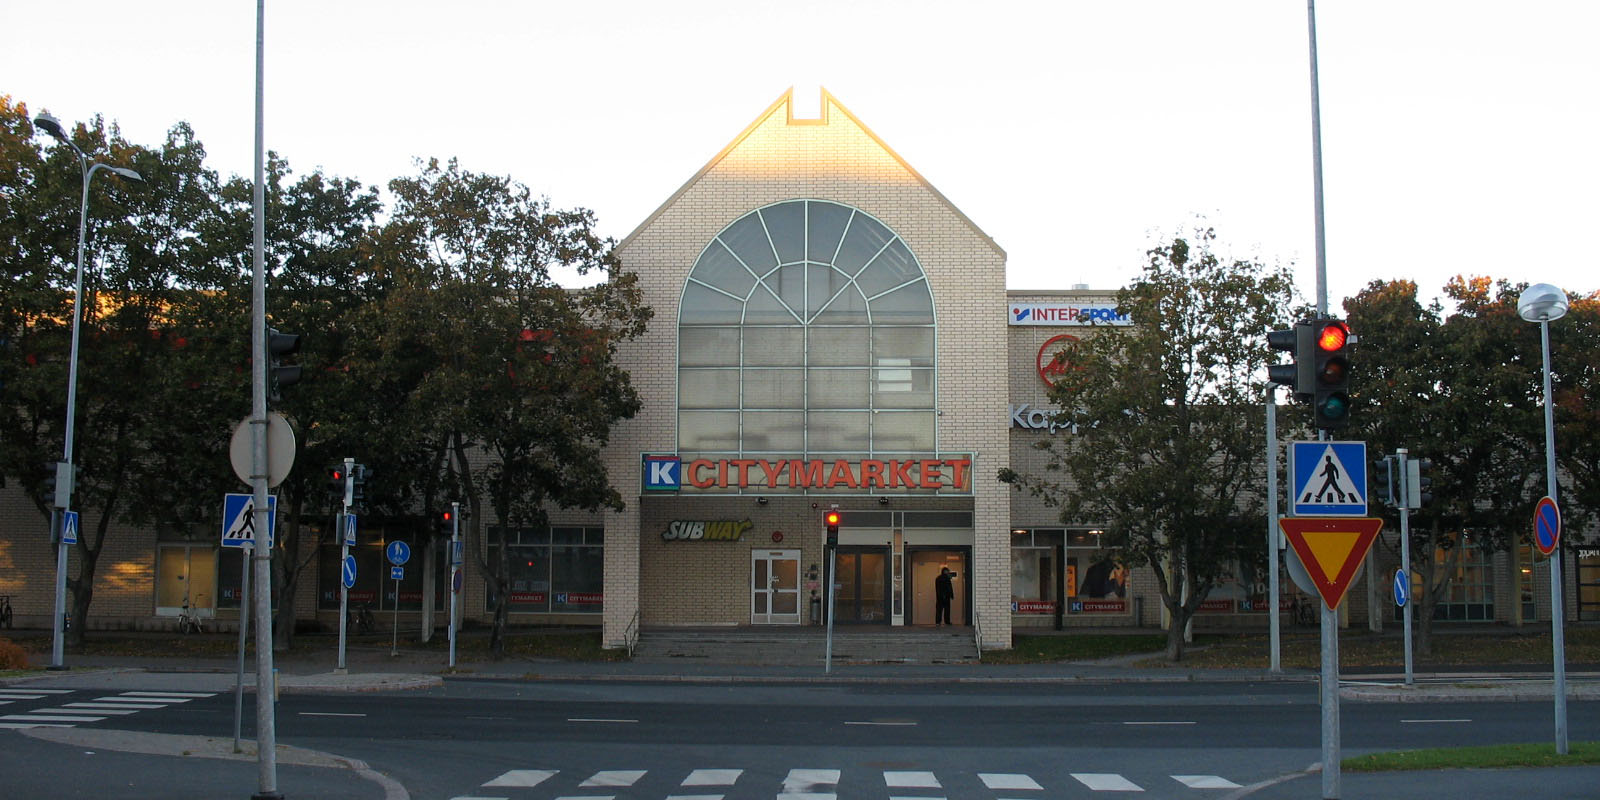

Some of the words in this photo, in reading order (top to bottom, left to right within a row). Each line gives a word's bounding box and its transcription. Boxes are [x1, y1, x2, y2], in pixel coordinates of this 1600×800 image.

[1032, 308, 1129, 321] INTERSPORT
[650, 462, 676, 484] K
[686, 458, 971, 489] CITYMARKET
[662, 520, 752, 541] SUBWAY
